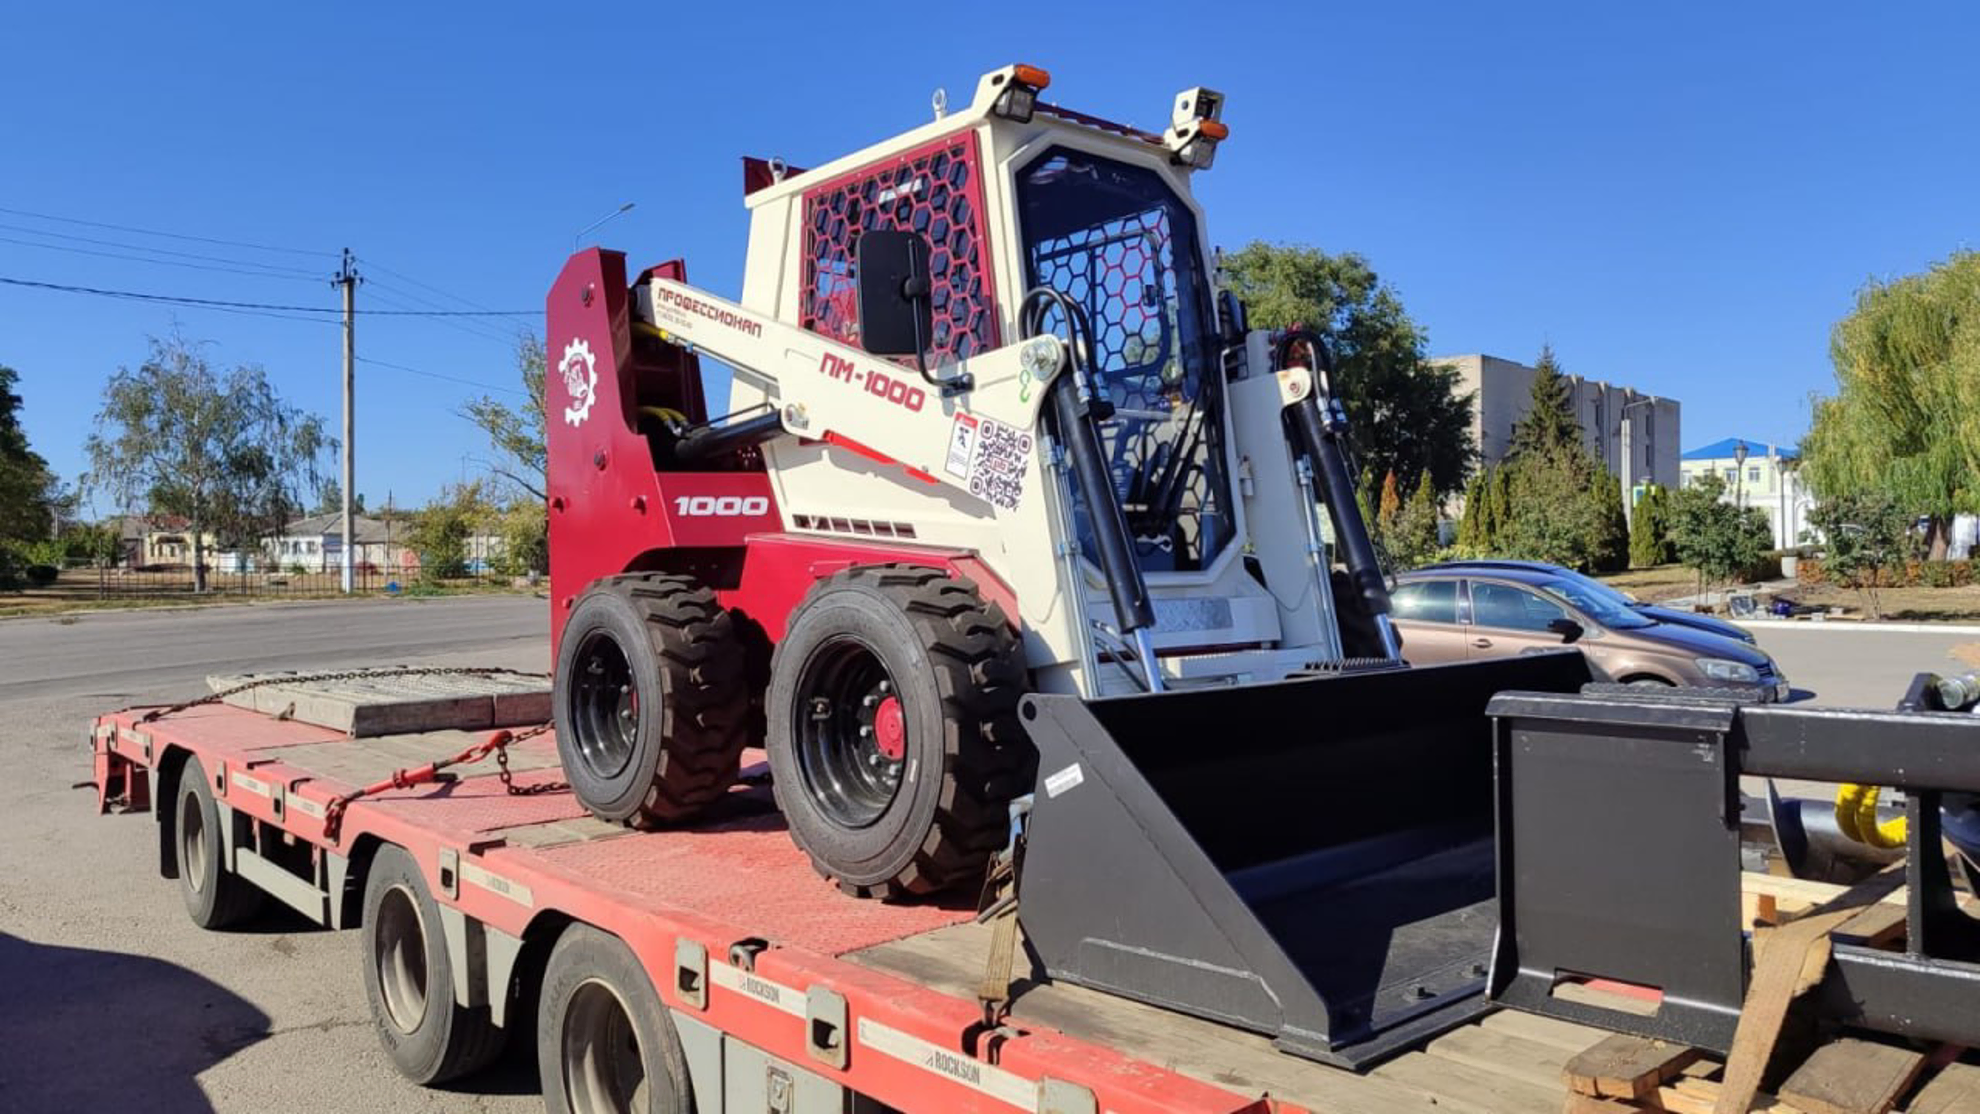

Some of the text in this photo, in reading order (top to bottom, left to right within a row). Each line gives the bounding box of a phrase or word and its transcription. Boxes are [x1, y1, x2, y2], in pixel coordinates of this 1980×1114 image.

[658, 287, 762, 339] ПРОФЕССИОНАЛ
[820, 352, 926, 412] ПМ-1000
[674, 496, 769, 516] 1000
[935, 1051, 981, 1085] ROCKSON
